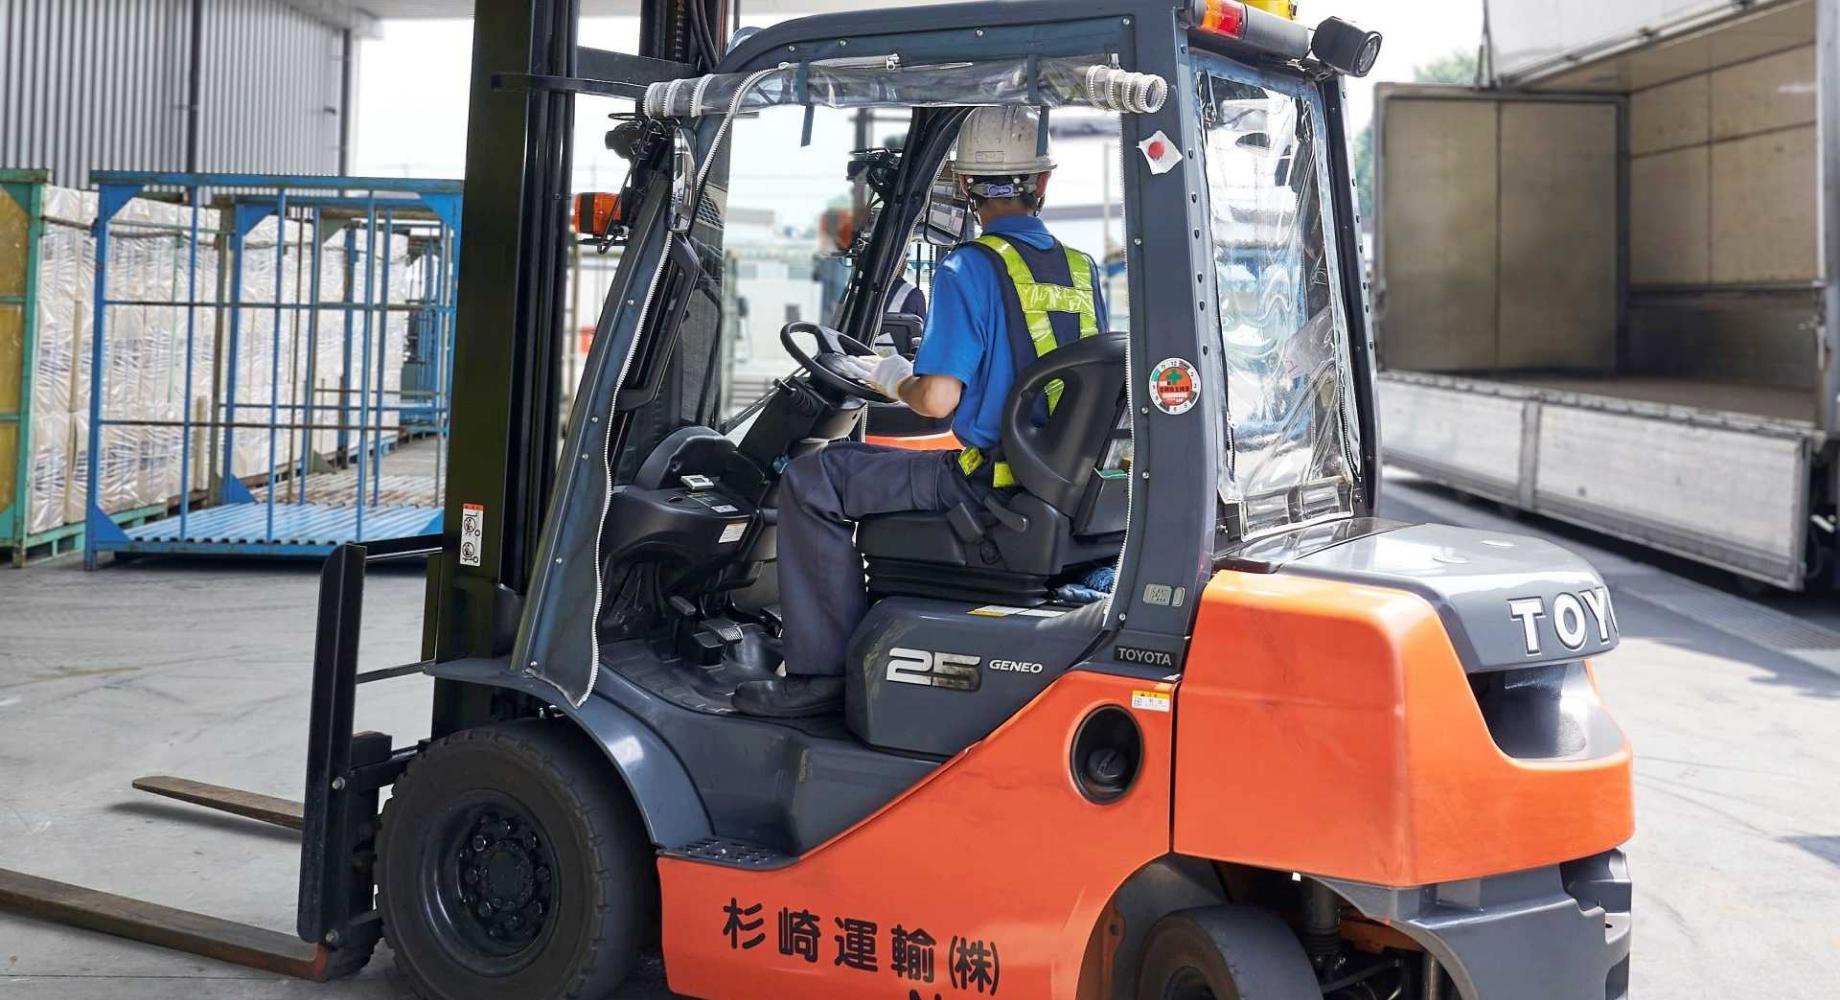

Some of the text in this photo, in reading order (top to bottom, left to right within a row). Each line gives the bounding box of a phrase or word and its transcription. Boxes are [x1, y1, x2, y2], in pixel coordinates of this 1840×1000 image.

[1507, 586, 1619, 655] TOY
[886, 647, 1043, 692] 25 GENEO
[1118, 647, 1172, 666] TOYOTA
